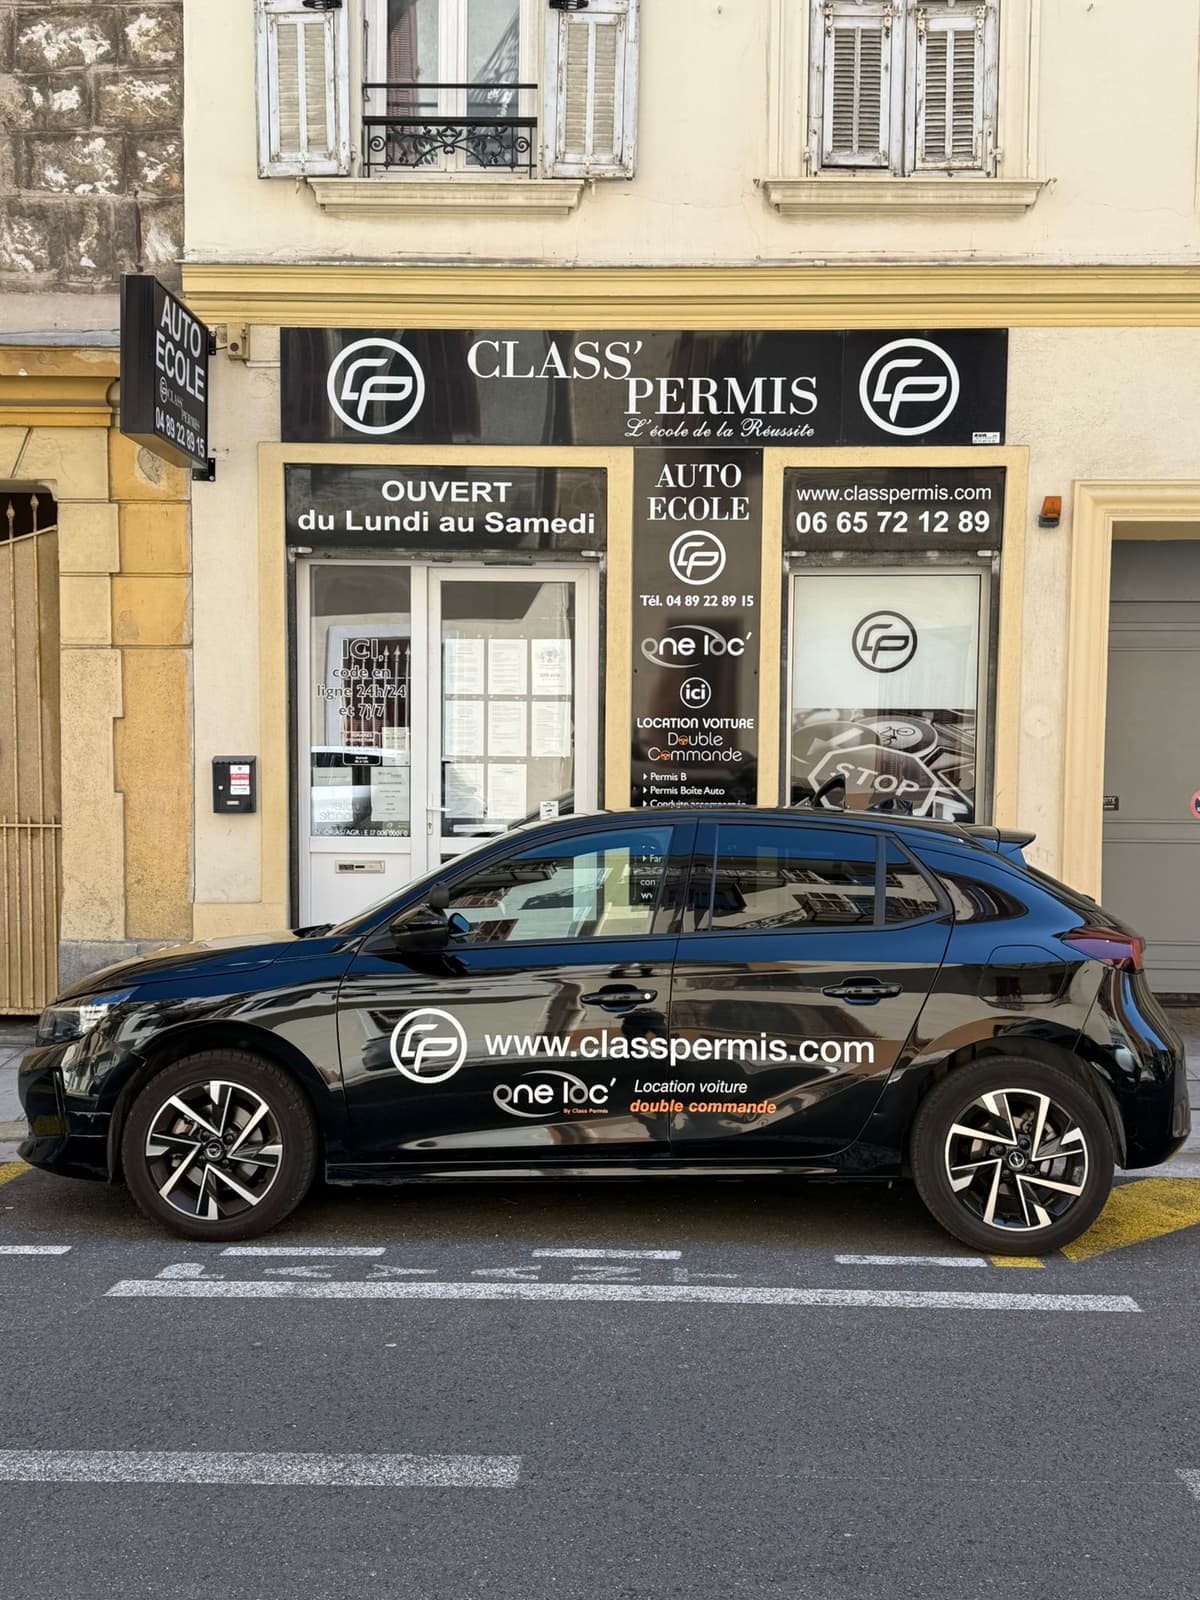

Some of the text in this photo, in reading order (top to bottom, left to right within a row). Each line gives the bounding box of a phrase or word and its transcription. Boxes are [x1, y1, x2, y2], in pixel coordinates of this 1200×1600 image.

[161, 295, 202, 359] AUTO
[155, 329, 205, 403] ECOLE
[467, 340, 643, 380] CLASS'
[624, 376, 819, 416] PERMIS
[155, 406, 205, 458] 04 89 22 89 15
[624, 417, 815, 438] L'école de la Réussite
[655, 463, 743, 488] AUTO
[381, 480, 513, 503] OUVERT
[796, 484, 993, 505] www.classpermis.com
[647, 496, 750, 521] ECOLE
[298, 509, 595, 534] du Lundi au Samedi
[796, 510, 991, 533] 06 65 72 12 89
[640, 594, 754, 607] Tél. 04 89 22 89 15
[342, 638, 384, 662] ICI,
[333, 664, 392, 679] code en
[317, 683, 408, 700] ligne 24h/24
[685, 684, 706, 700] ici
[338, 703, 386, 720] et 7j/7
[637, 717, 755, 729] LOCATION VOITURE
[650, 772, 688, 781] Permis B
[830, 762, 921, 796] STOP
[650, 786, 679, 795] Permis
[703, 787, 726, 796] Auto
[484, 1029, 875, 1067] www.classpermis.com
[633, 1079, 748, 1094] Location voiture
[629, 1098, 778, 1115] double commande
